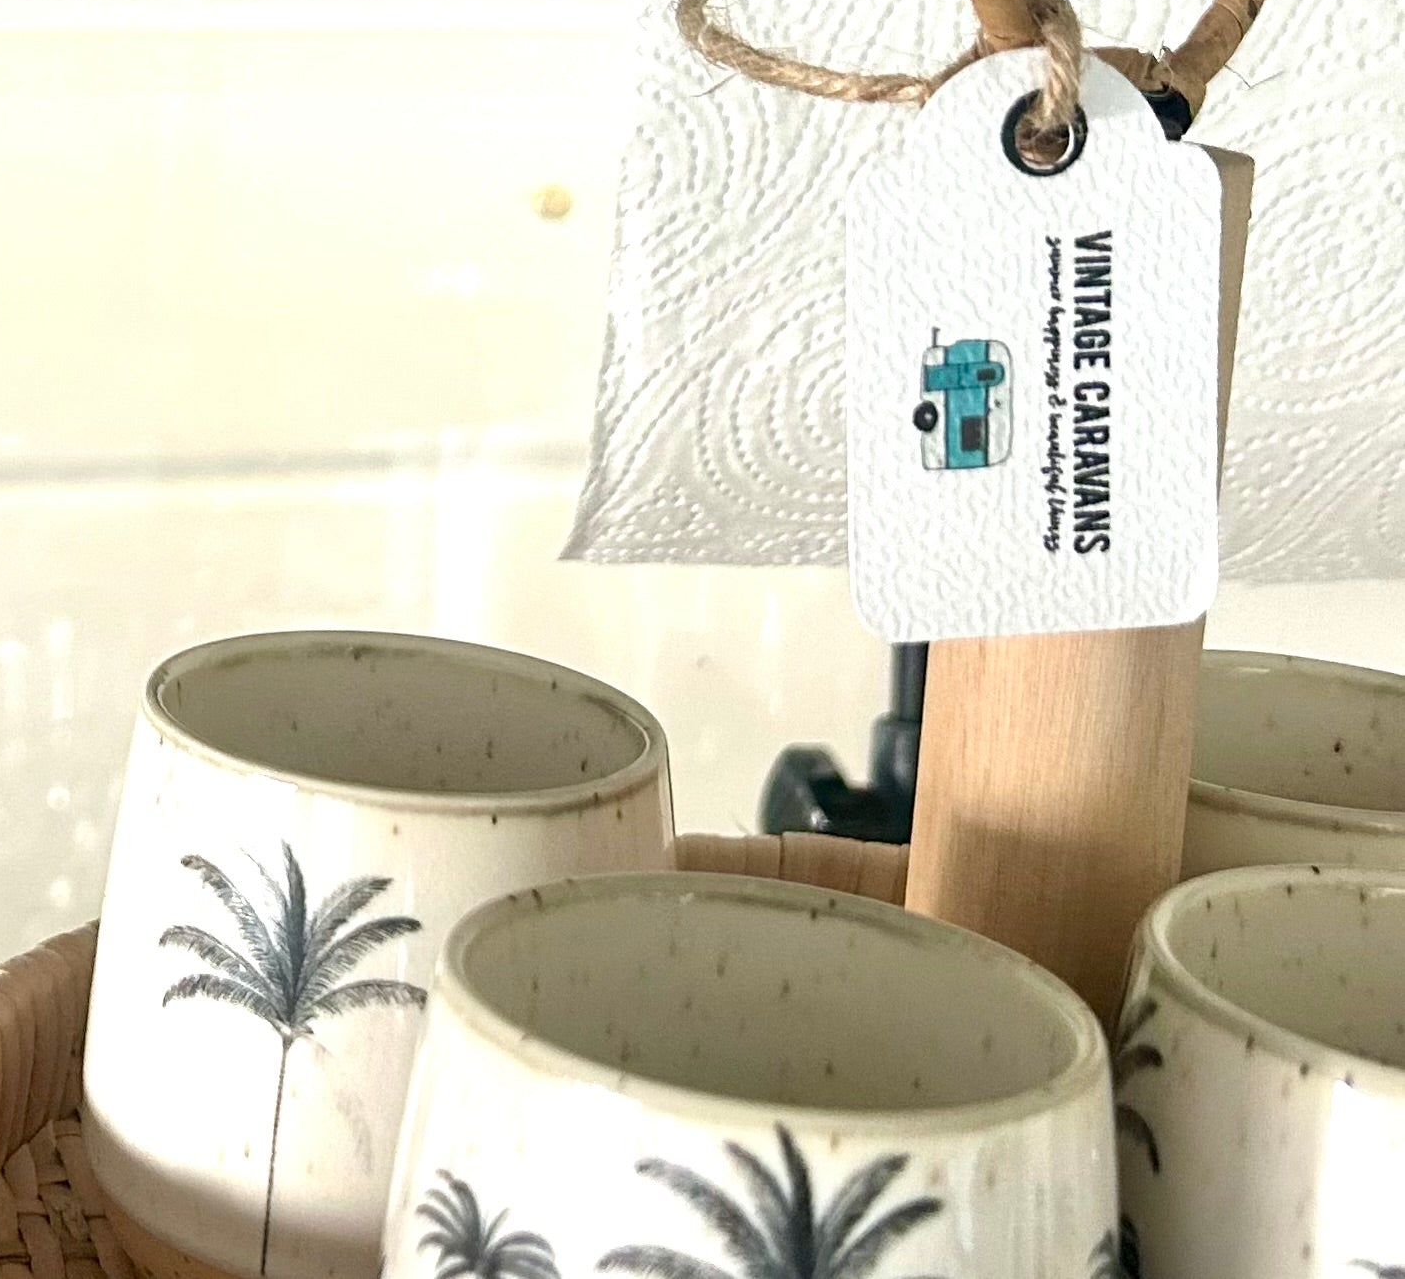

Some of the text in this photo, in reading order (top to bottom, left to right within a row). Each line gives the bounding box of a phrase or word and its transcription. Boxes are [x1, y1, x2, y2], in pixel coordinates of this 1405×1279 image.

[1043, 306, 1067, 391] happiness
[1073, 230, 1113, 555] VINTAGE CARAVANS
